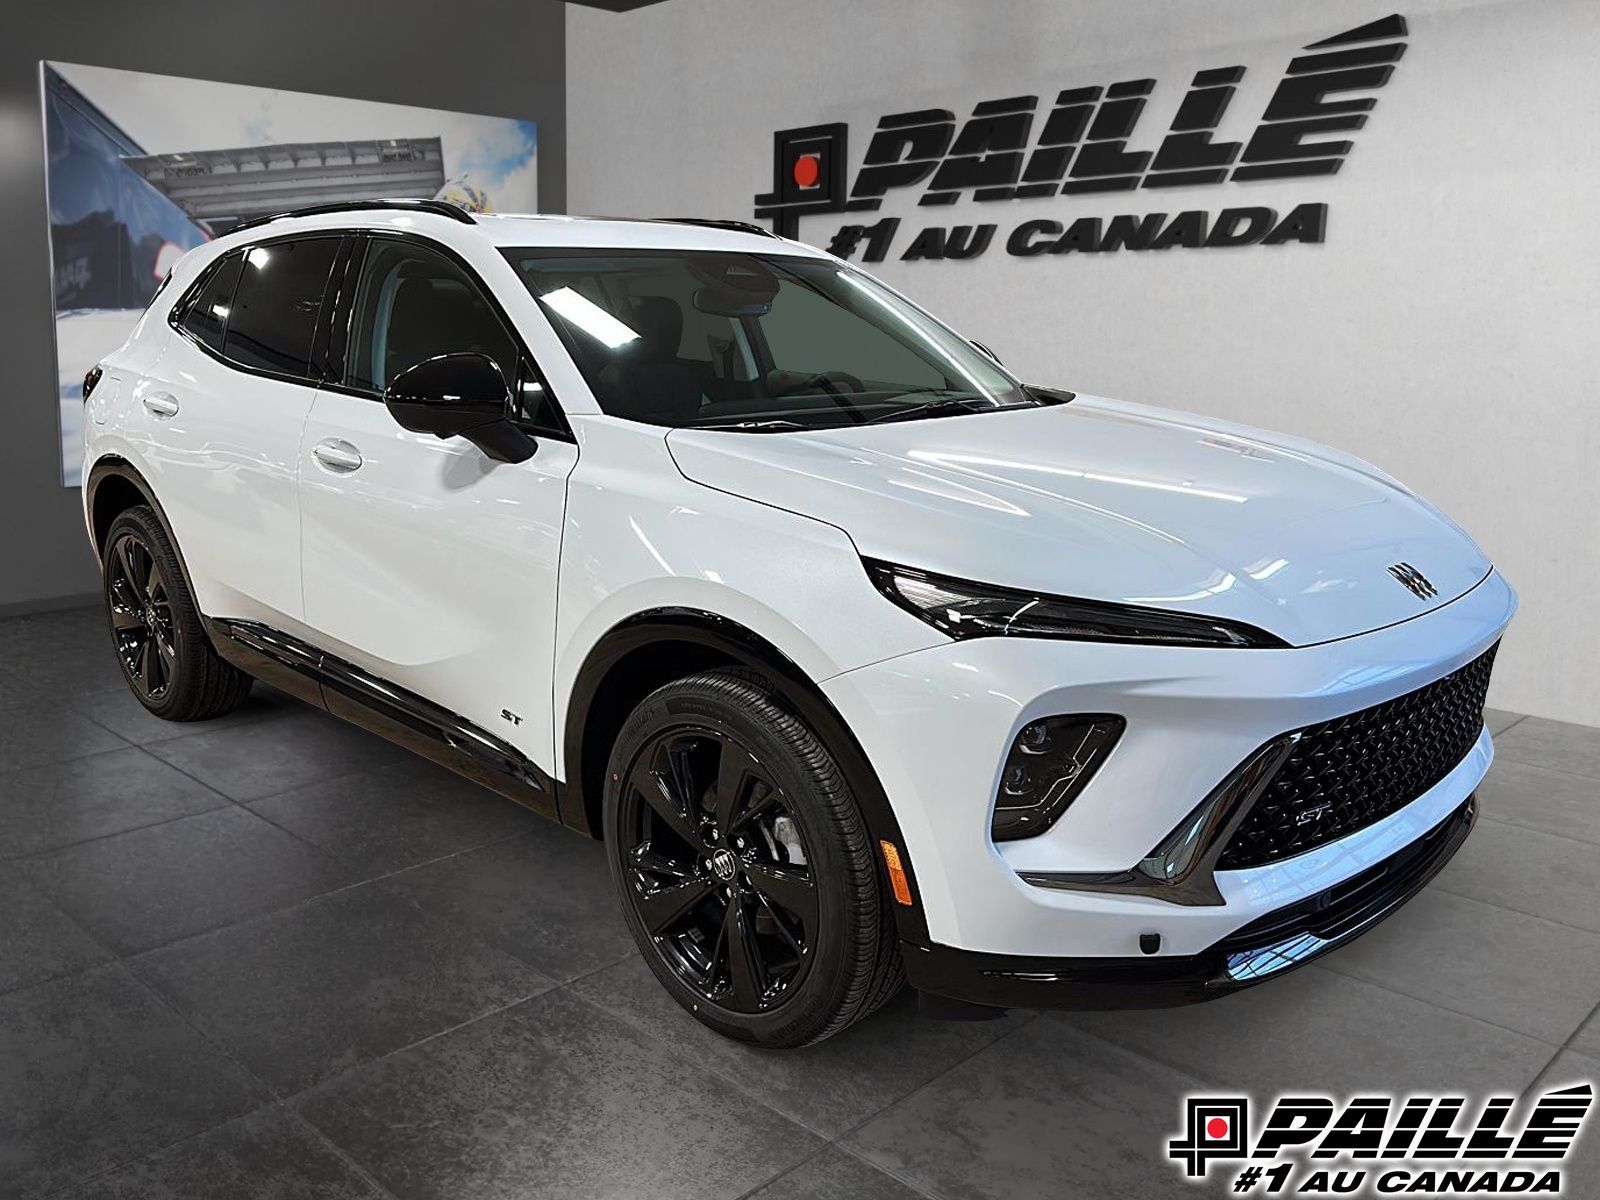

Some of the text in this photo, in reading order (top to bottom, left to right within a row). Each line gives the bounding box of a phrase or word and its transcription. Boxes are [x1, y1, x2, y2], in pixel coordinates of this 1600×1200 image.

[826, 202, 1328, 263] #1 AU CANADA
[501, 709, 523, 725] ST
